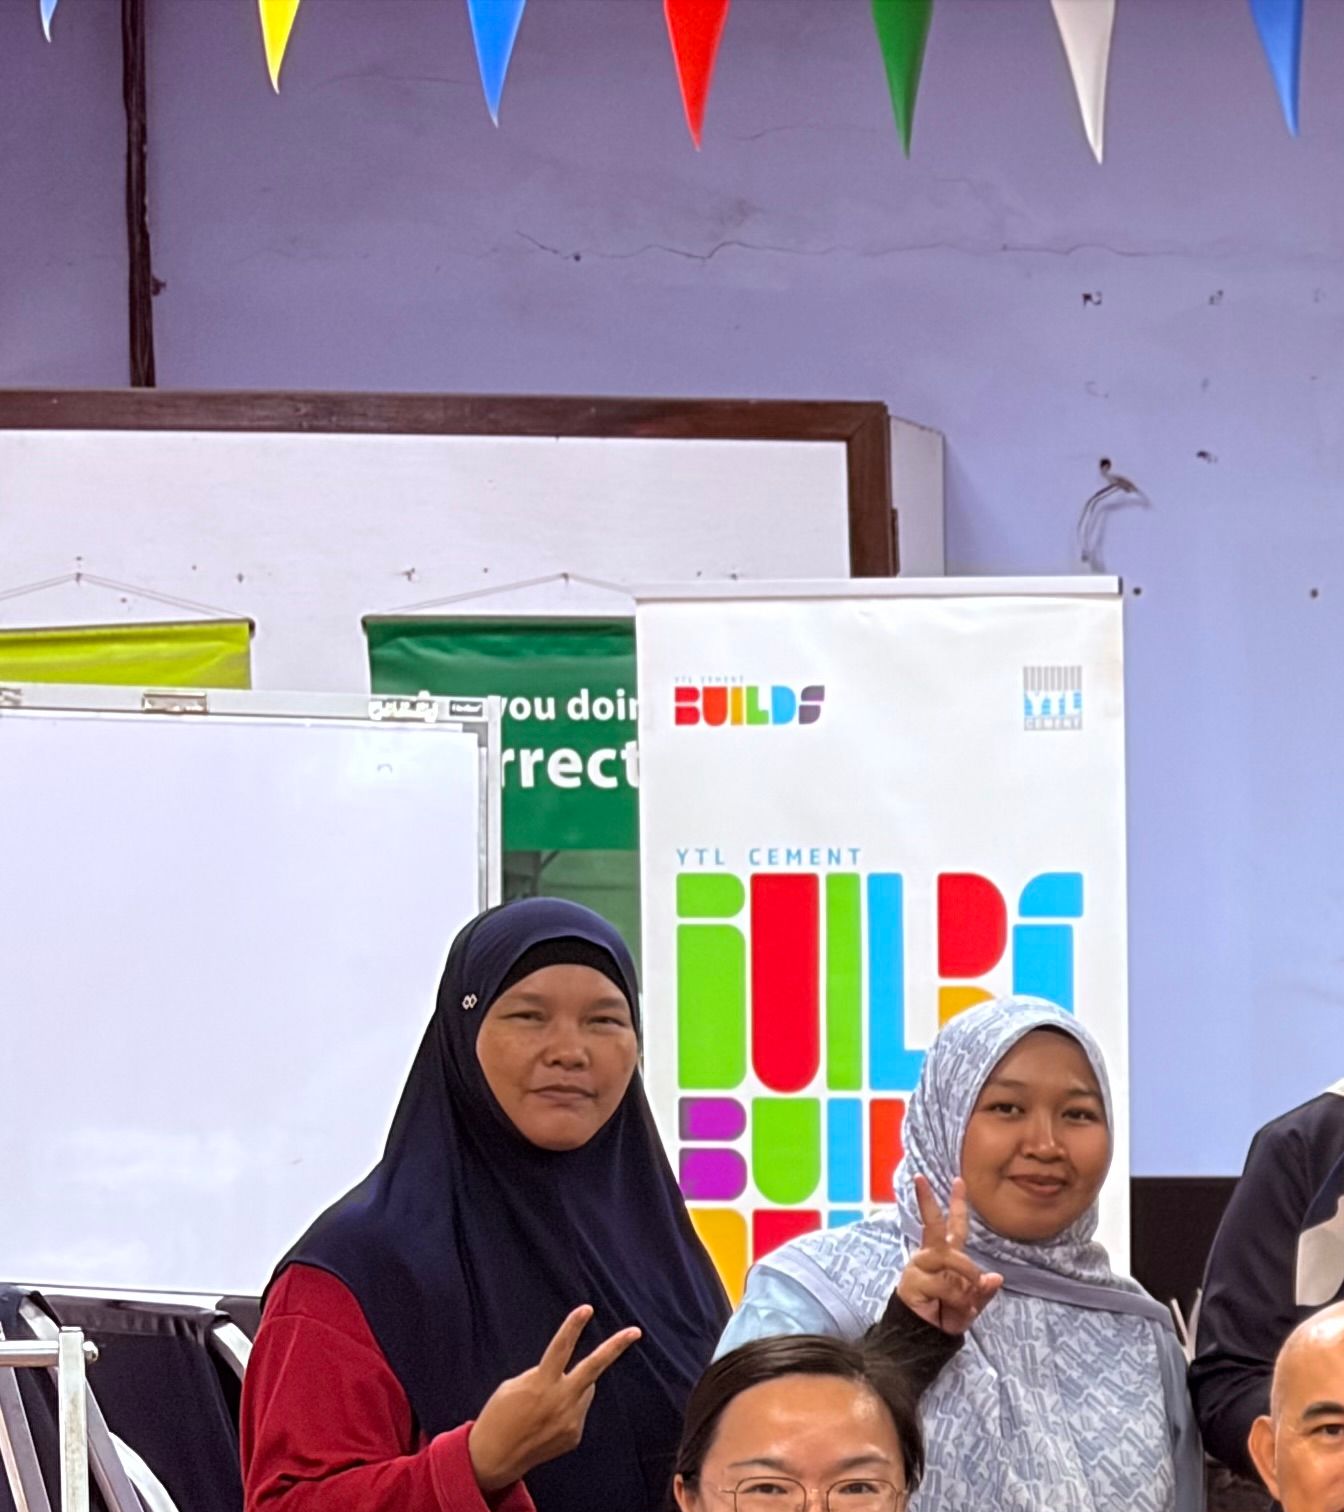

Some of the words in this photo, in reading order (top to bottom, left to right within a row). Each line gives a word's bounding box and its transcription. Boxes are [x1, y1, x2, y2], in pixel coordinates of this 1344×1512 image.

[567, 688, 639, 720] doi
[675, 685, 825, 726] BUILDS
[677, 849, 725, 866] YTL
[749, 848, 861, 866] CEMENT
